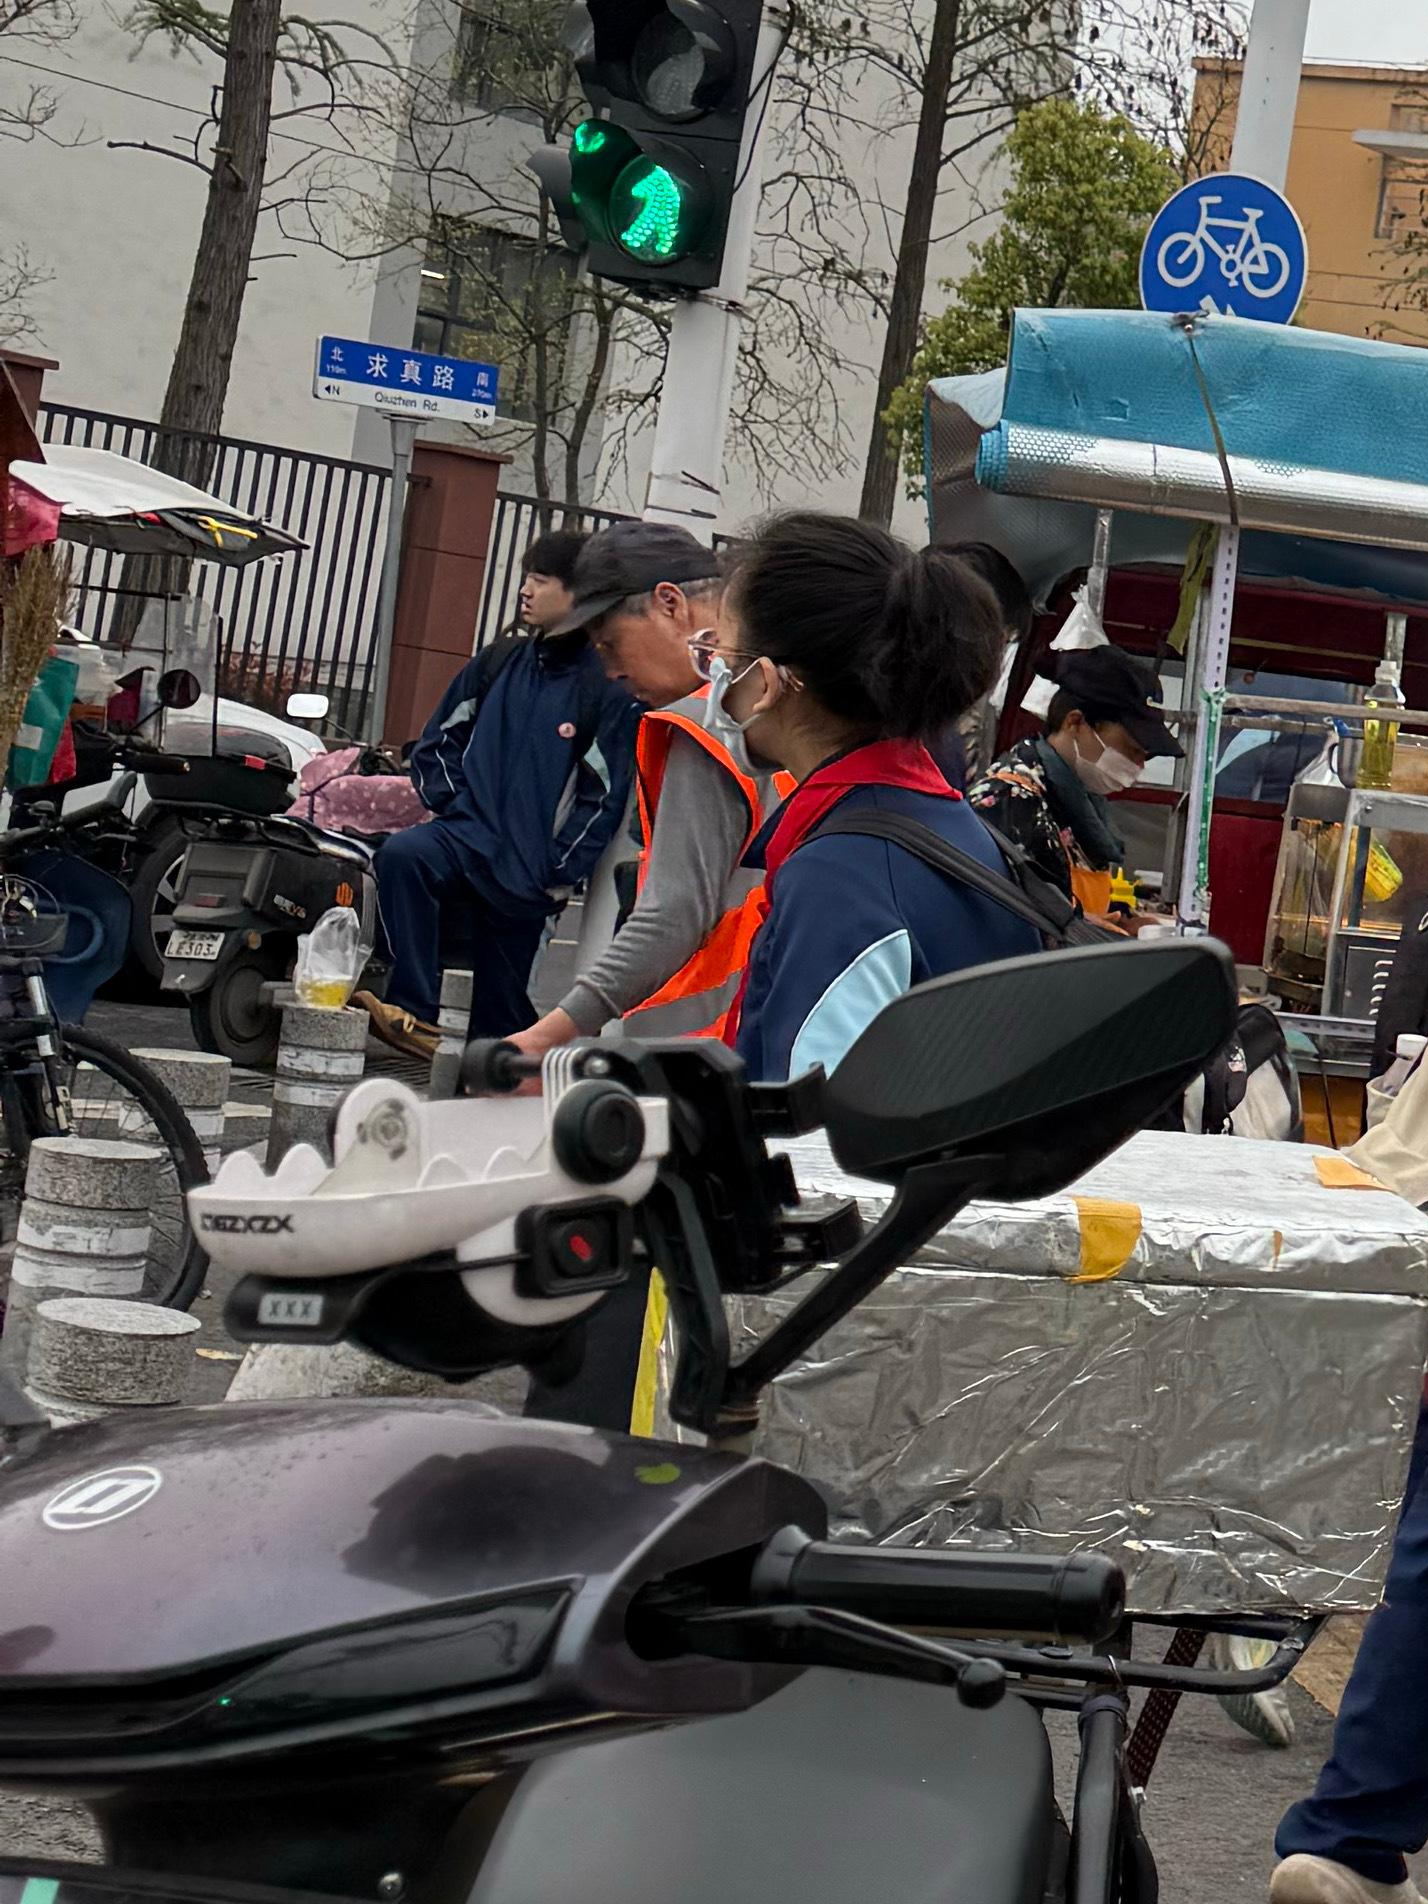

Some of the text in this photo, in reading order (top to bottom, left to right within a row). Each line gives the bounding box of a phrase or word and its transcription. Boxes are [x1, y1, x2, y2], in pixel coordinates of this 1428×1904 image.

[330, 346, 345, 362] 北
[366, 352, 454, 391] 求真路
[332, 385, 340, 396] N
[375, 391, 440, 412] Qiuzhen Rd.
[474, 407, 482, 419] S
